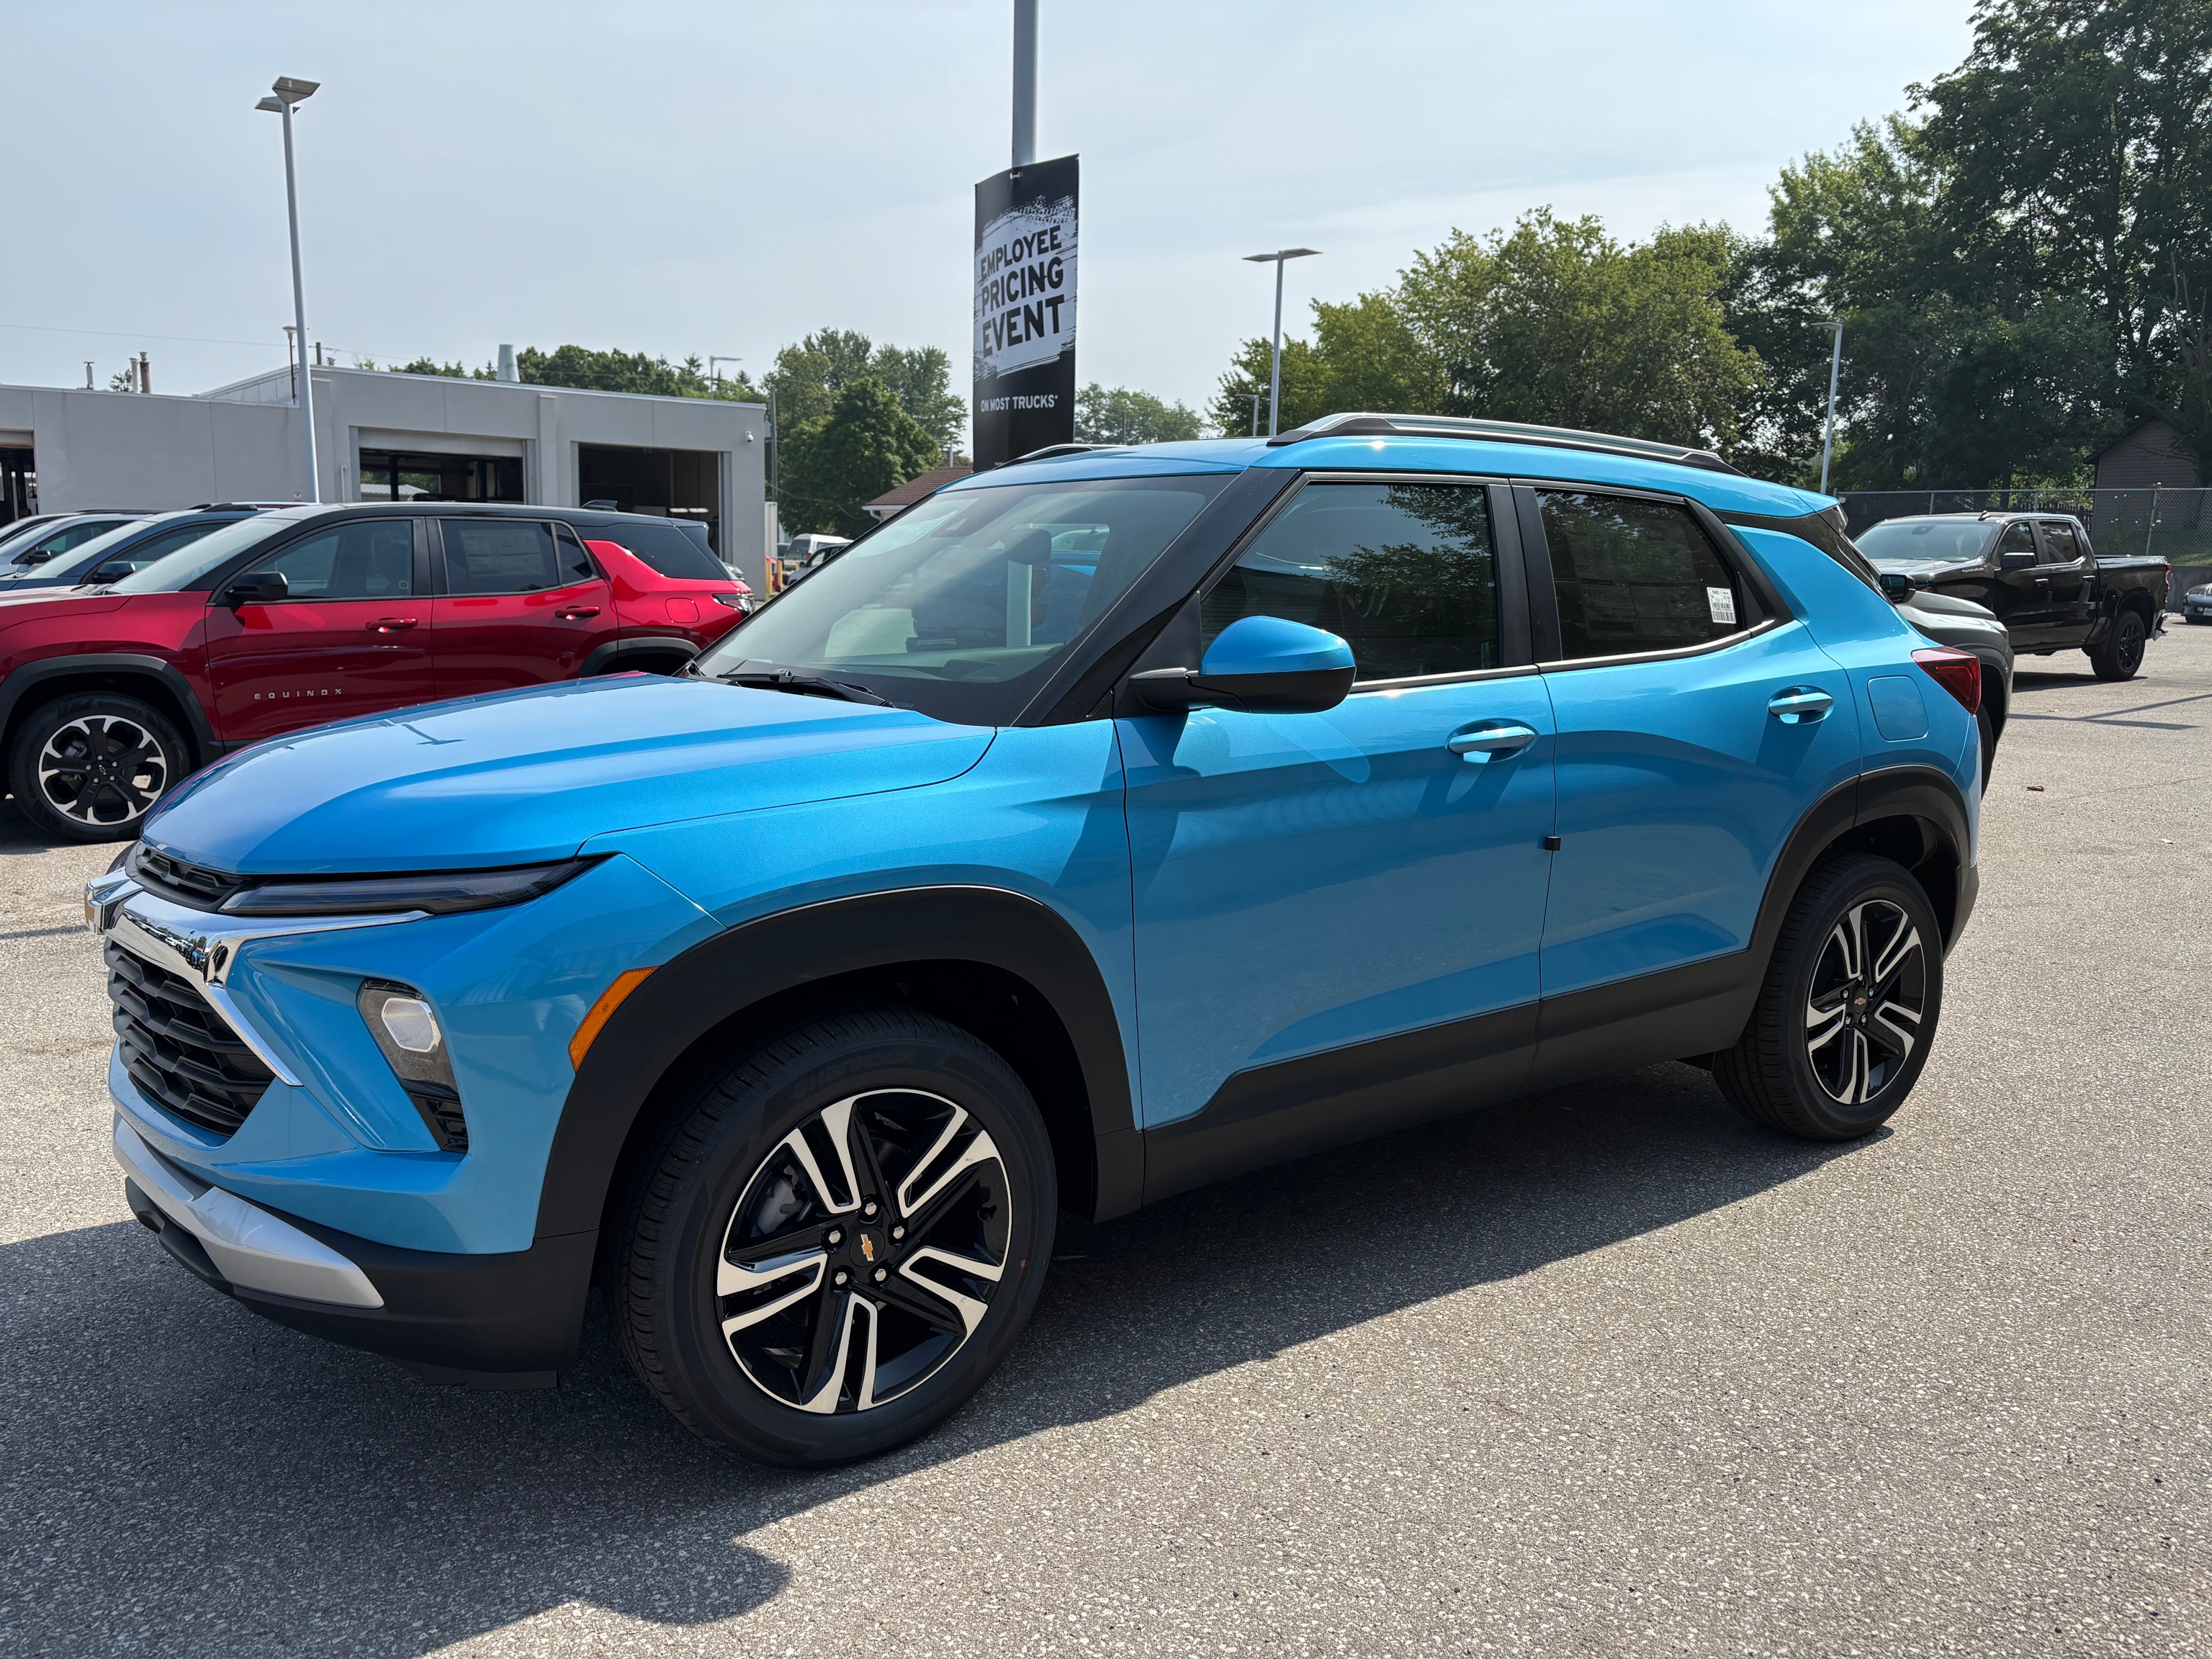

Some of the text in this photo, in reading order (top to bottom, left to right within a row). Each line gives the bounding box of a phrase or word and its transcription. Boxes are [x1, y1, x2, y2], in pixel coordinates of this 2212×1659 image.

[981, 225, 1062, 282] EMPLOYEE
[981, 256, 1064, 317] PRICING
[983, 294, 1064, 358] EVENT
[980, 400, 989, 412] ON
[990, 397, 1010, 410] MOST
[254, 688, 341, 699] EQUINOX
